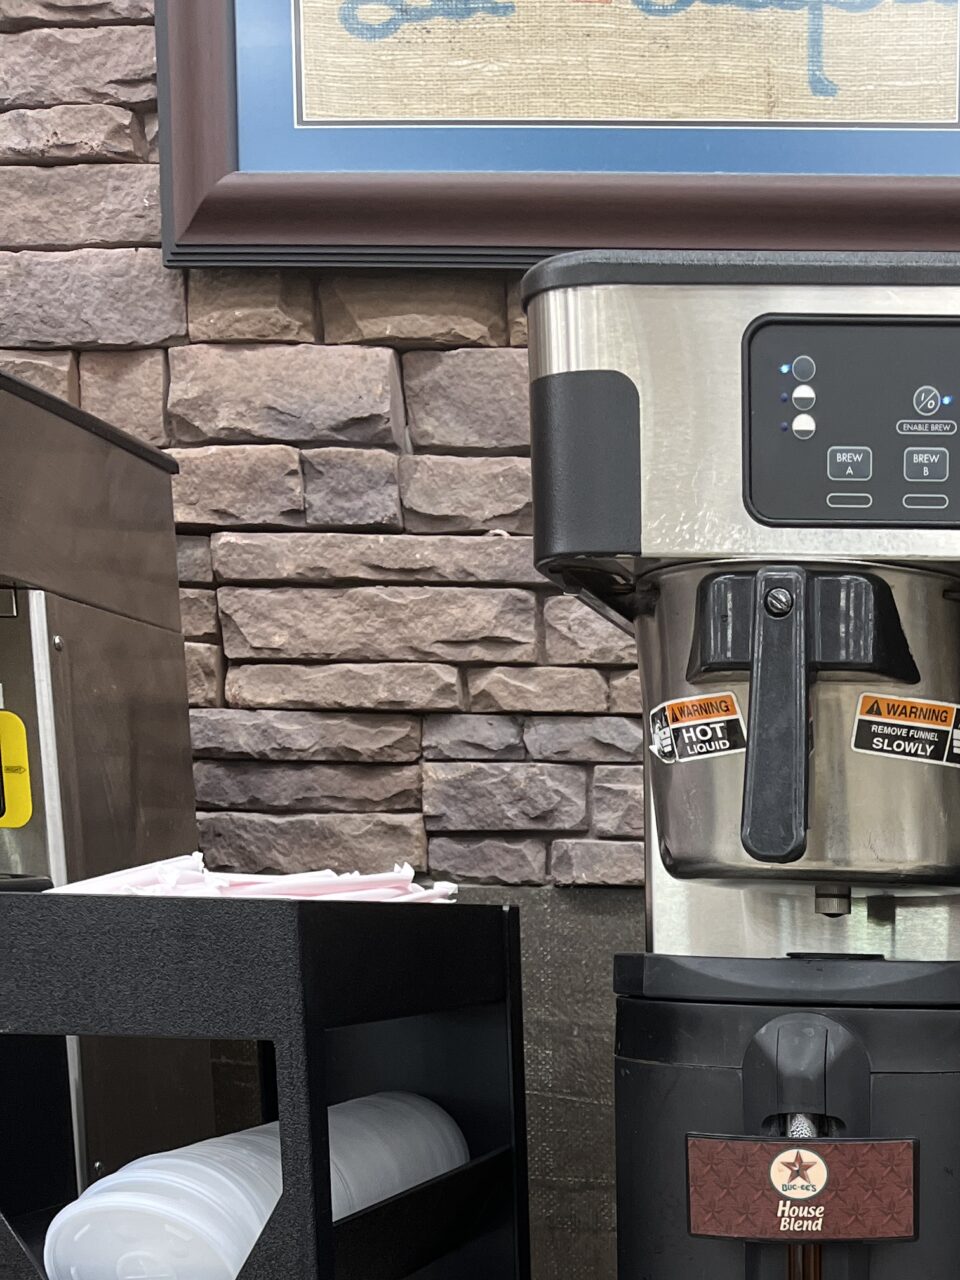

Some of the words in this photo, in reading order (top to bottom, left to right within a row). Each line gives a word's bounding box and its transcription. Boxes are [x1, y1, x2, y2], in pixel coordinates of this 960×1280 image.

[903, 424, 929, 432] ENABLE
[930, 424, 951, 432] BREW
[836, 453, 863, 463] BREW
[913, 454, 940, 464] BREW
[845, 466, 854, 476] A
[923, 467, 929, 476] B
[677, 700, 730, 719] WARNING
[886, 703, 948, 722] WARNING
[682, 723, 725, 743] HOT
[871, 724, 907, 737] REMOVE
[909, 729, 939, 741] FUNNEL
[687, 740, 730, 754] LIQUID
[872, 737, 935, 756] SLOWLY
[777, 1200, 825, 1217] House
[779, 1217, 823, 1231] Blend
